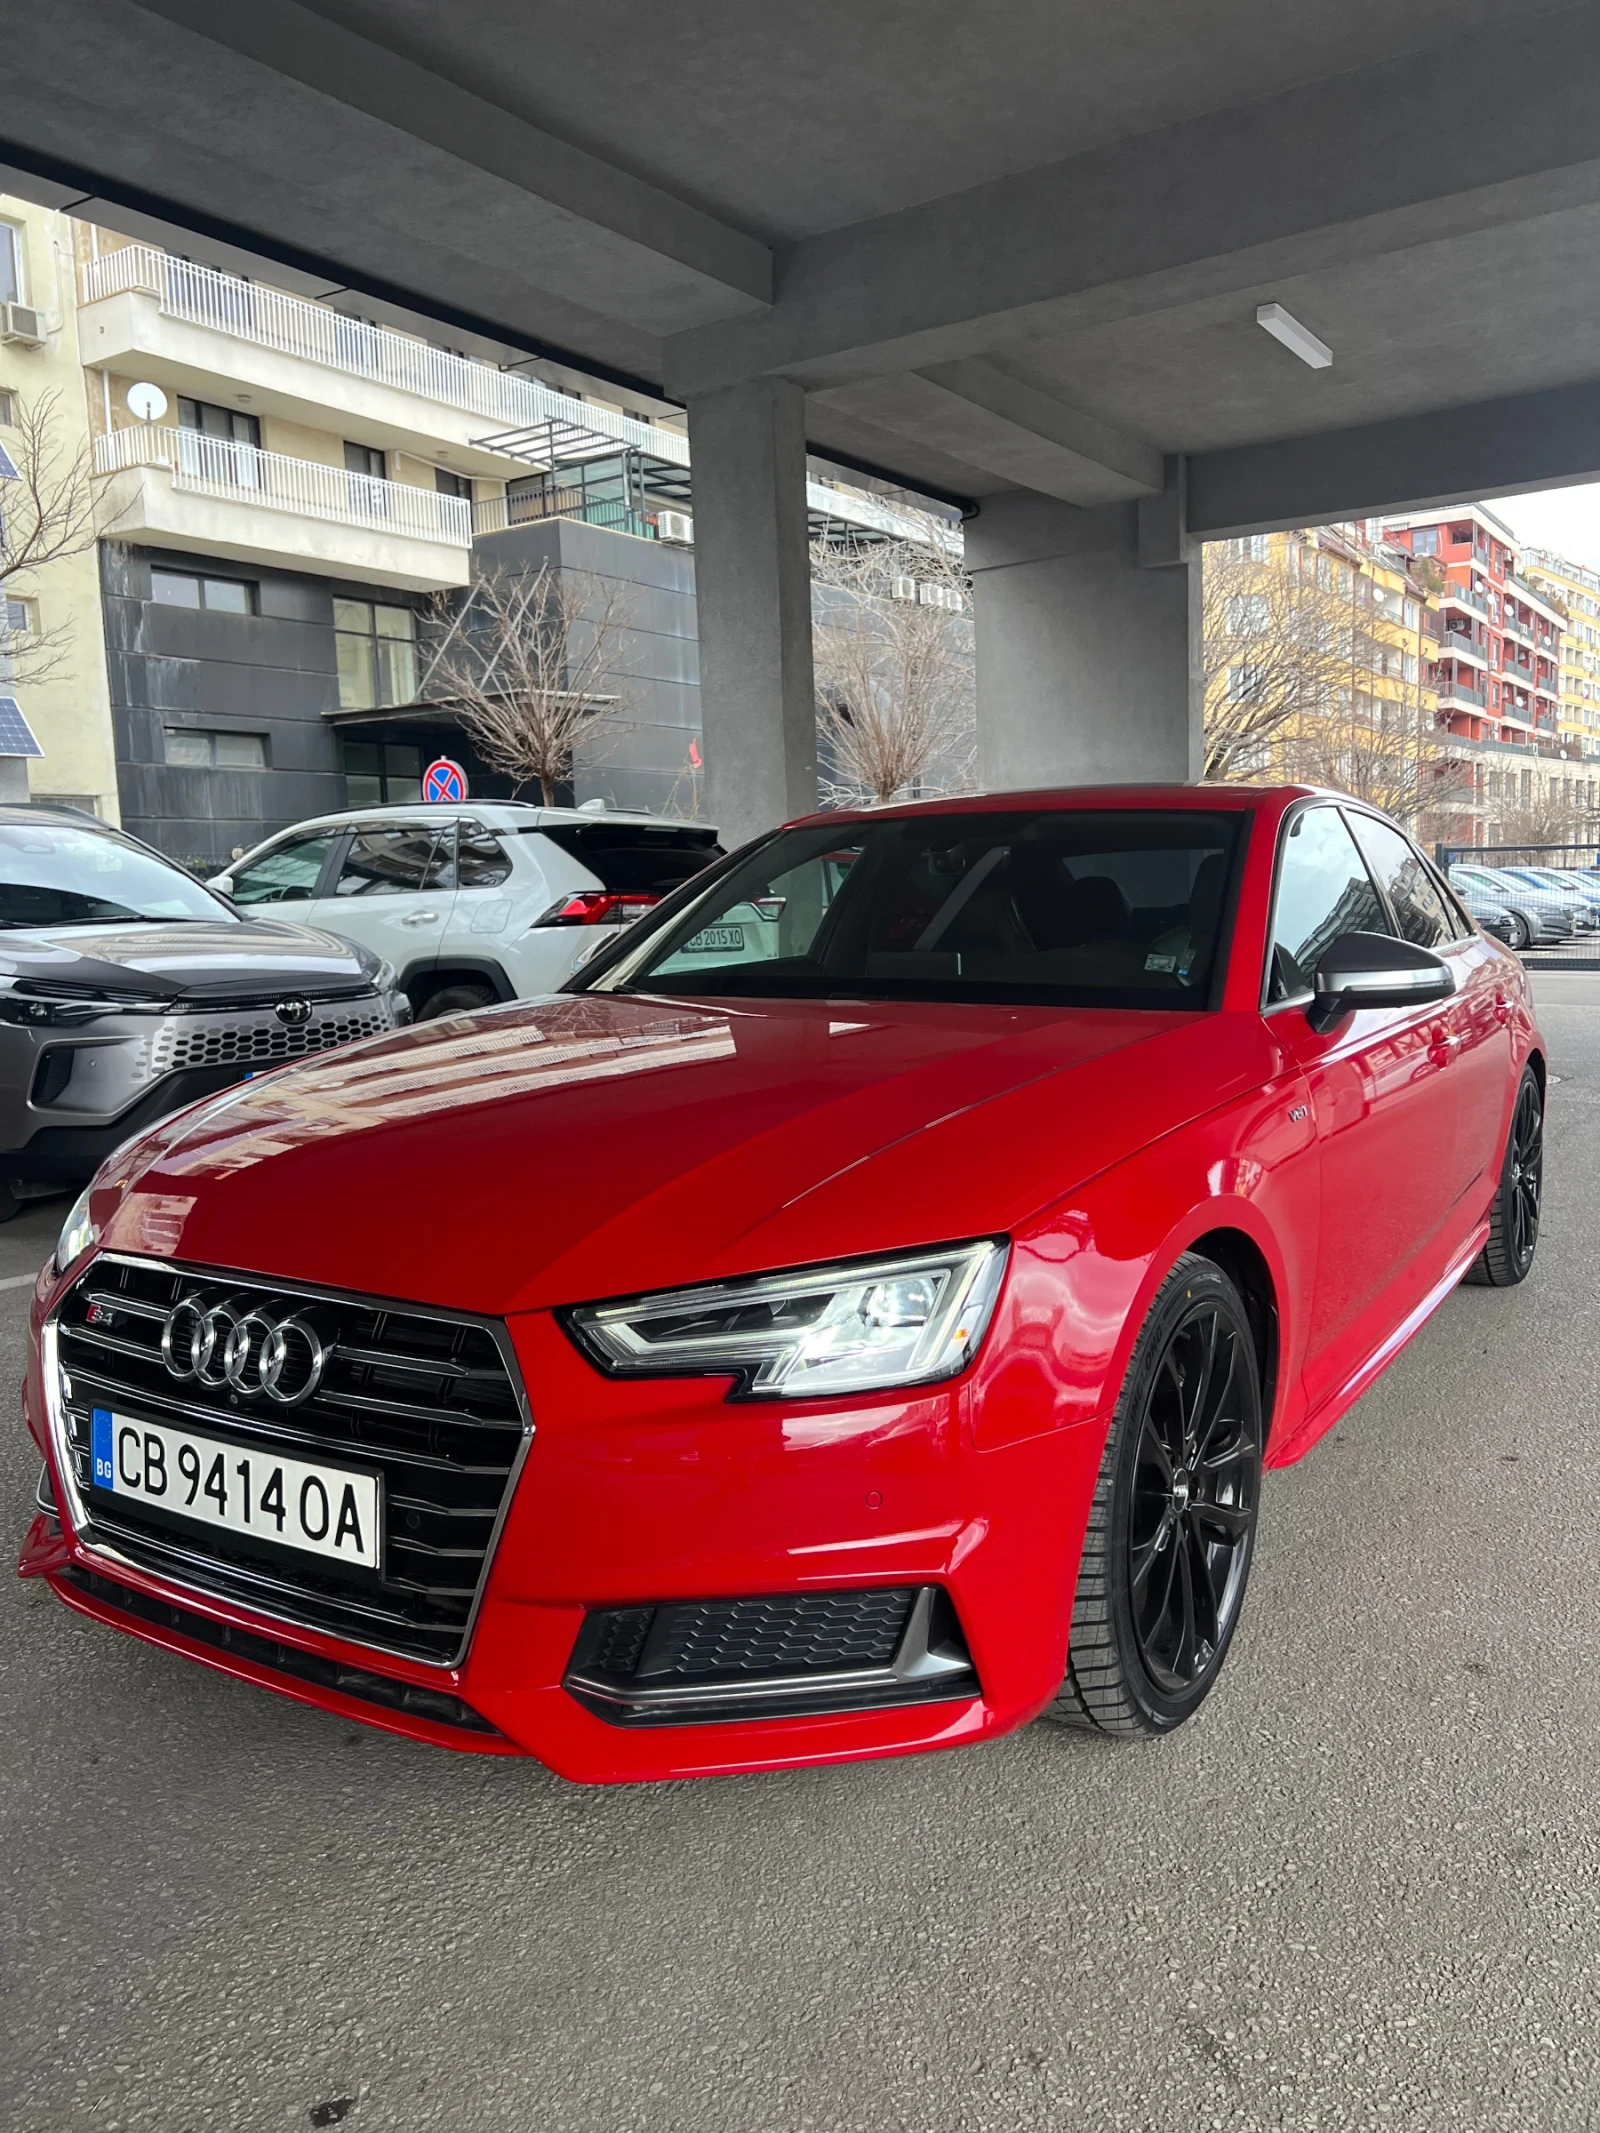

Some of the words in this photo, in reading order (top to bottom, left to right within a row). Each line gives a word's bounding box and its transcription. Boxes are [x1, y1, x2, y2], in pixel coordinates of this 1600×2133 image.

[704, 930, 727, 946] 2015
[91, 1309, 113, 1326] S4
[96, 1458, 112, 1479] BG
[119, 1427, 167, 1496] CB
[178, 1444, 287, 1533] 9414
